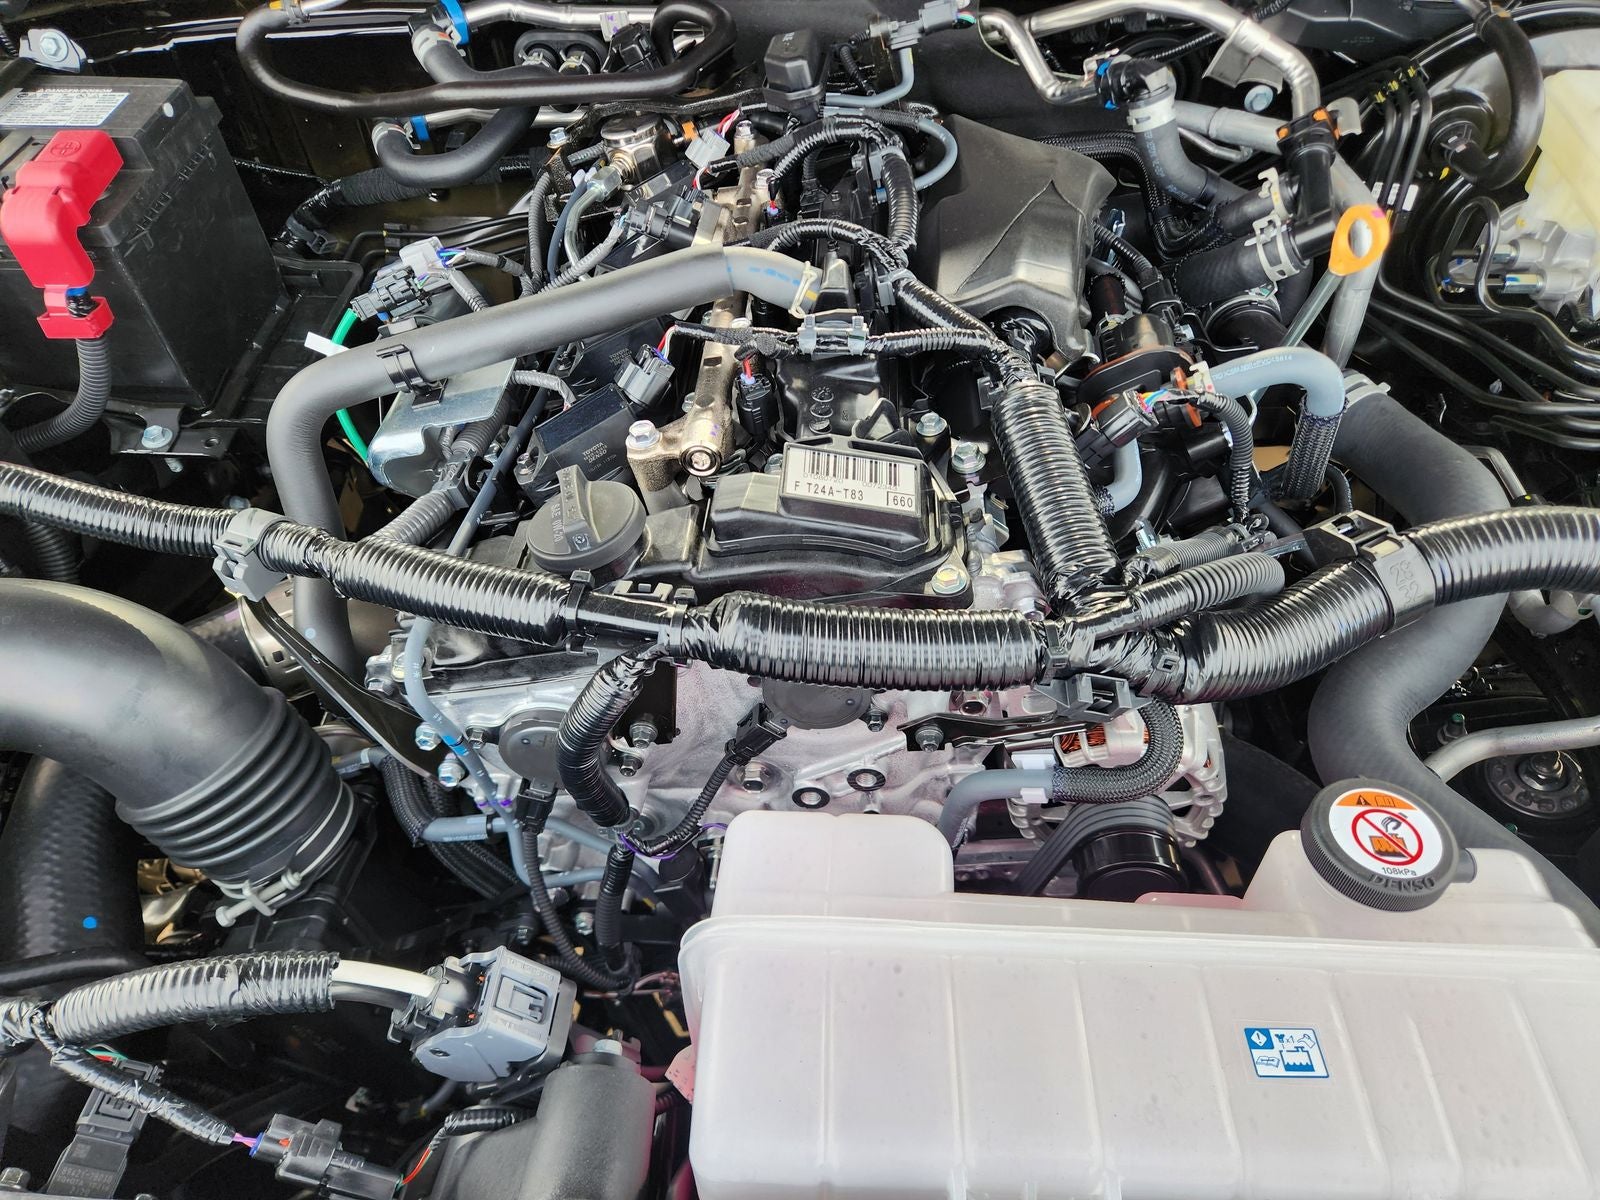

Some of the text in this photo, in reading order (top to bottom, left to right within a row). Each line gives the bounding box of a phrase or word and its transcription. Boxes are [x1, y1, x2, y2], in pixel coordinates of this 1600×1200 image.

[582, 441, 603, 456] TOYOTA
[588, 449, 607, 463] DENSO
[794, 480, 864, 501] F T24A-T83
[892, 495, 913, 508] 660
[1381, 866, 1417, 876] 108kPa
